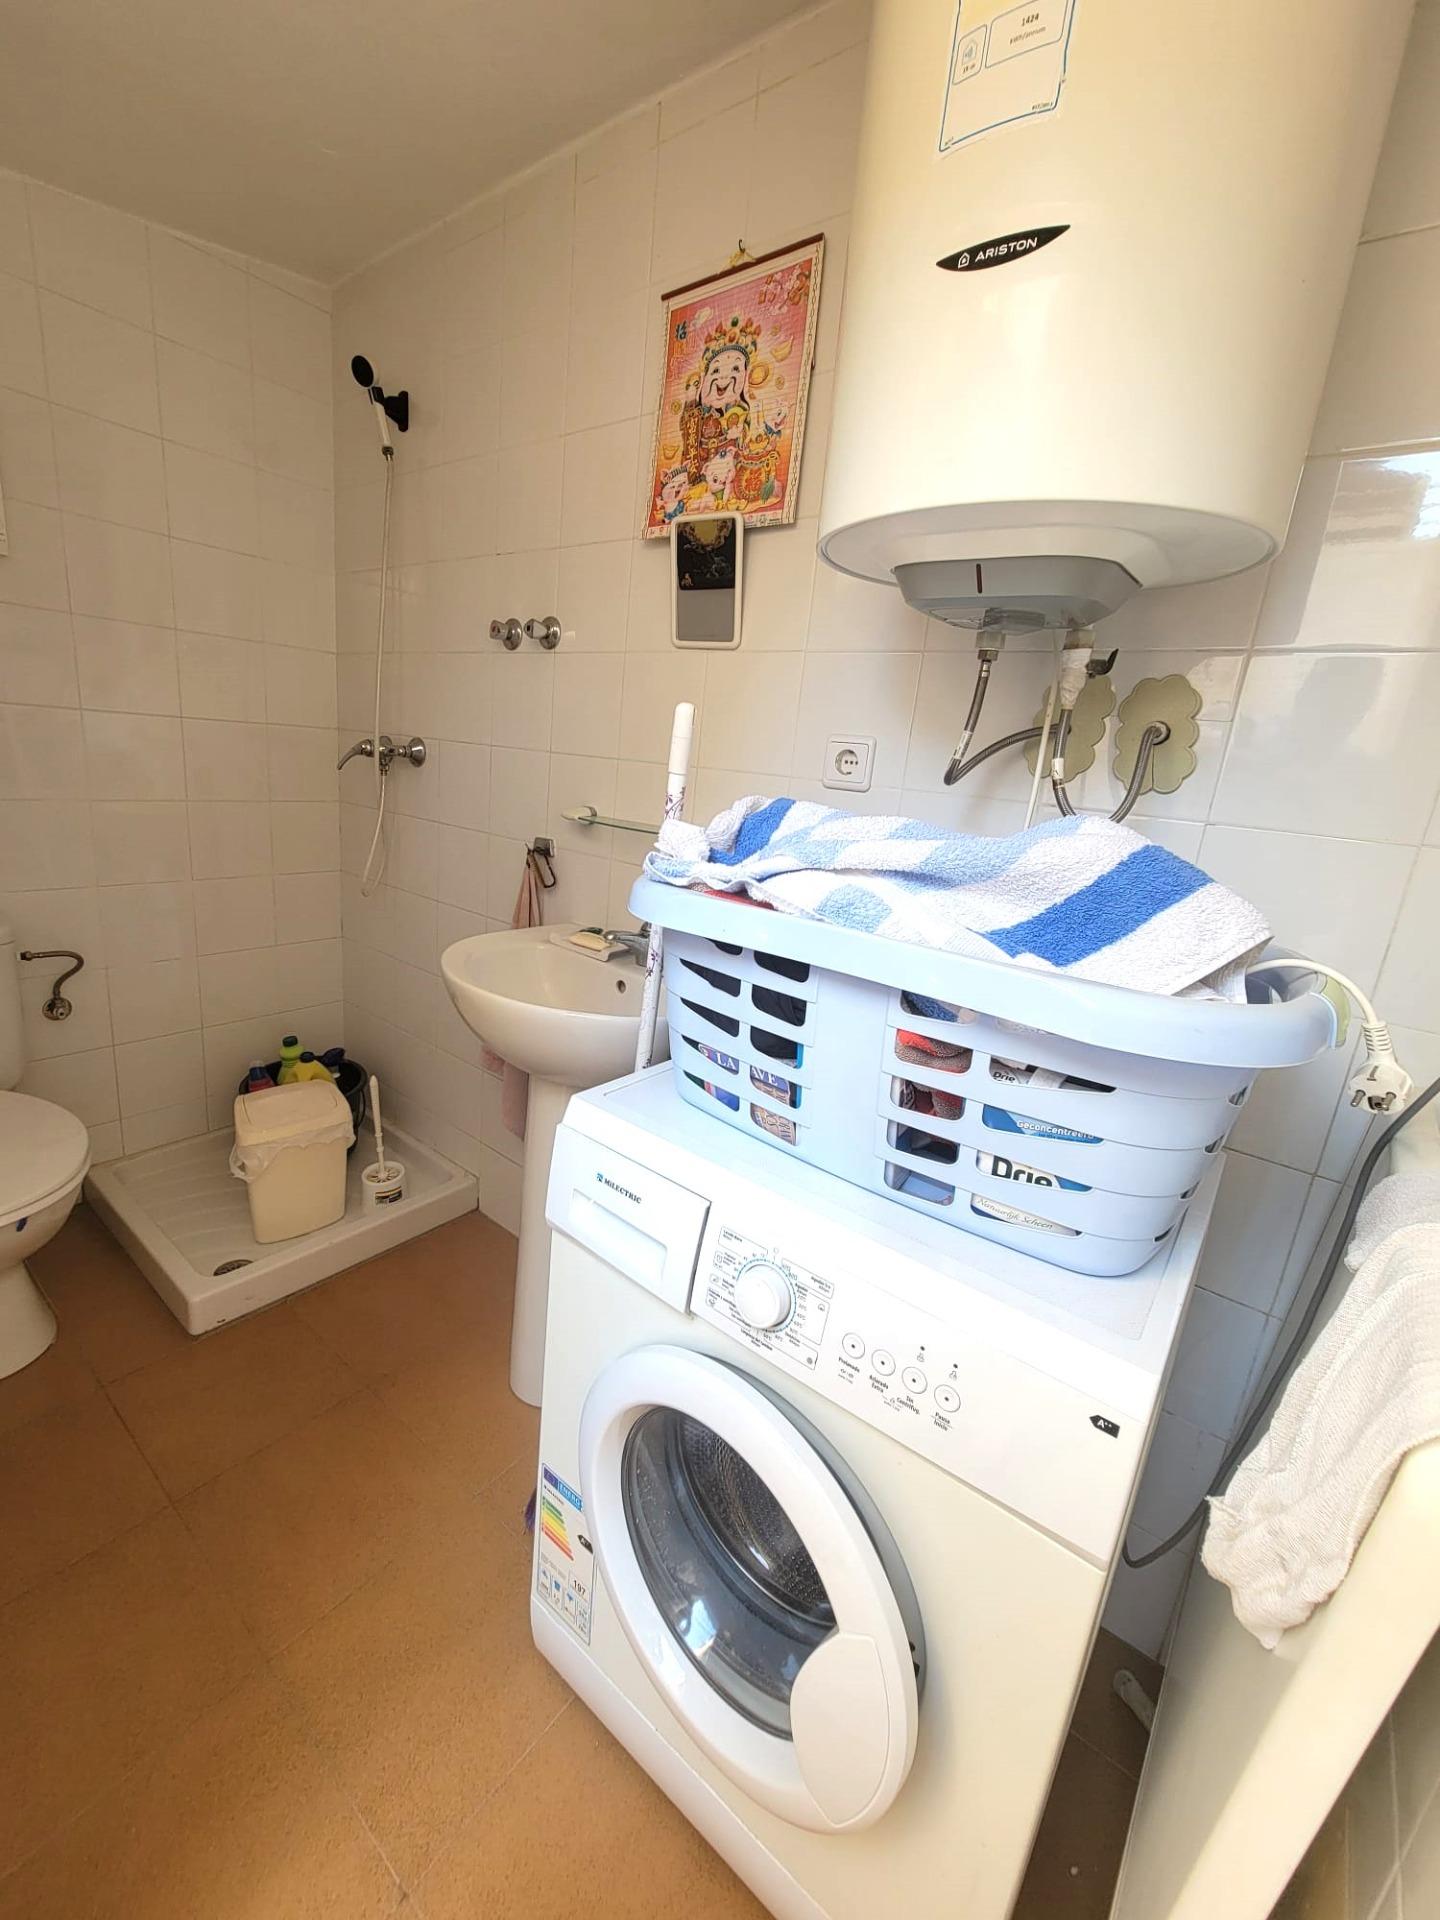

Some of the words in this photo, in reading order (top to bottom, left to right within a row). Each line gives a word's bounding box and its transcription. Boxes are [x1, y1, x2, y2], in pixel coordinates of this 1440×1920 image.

[1021, 12, 1040, 27] 1424
[975, 237, 1038, 262] ARISTON
[993, 1071, 1016, 1083] Drie
[934, 1411, 951, 1425] Pausa
